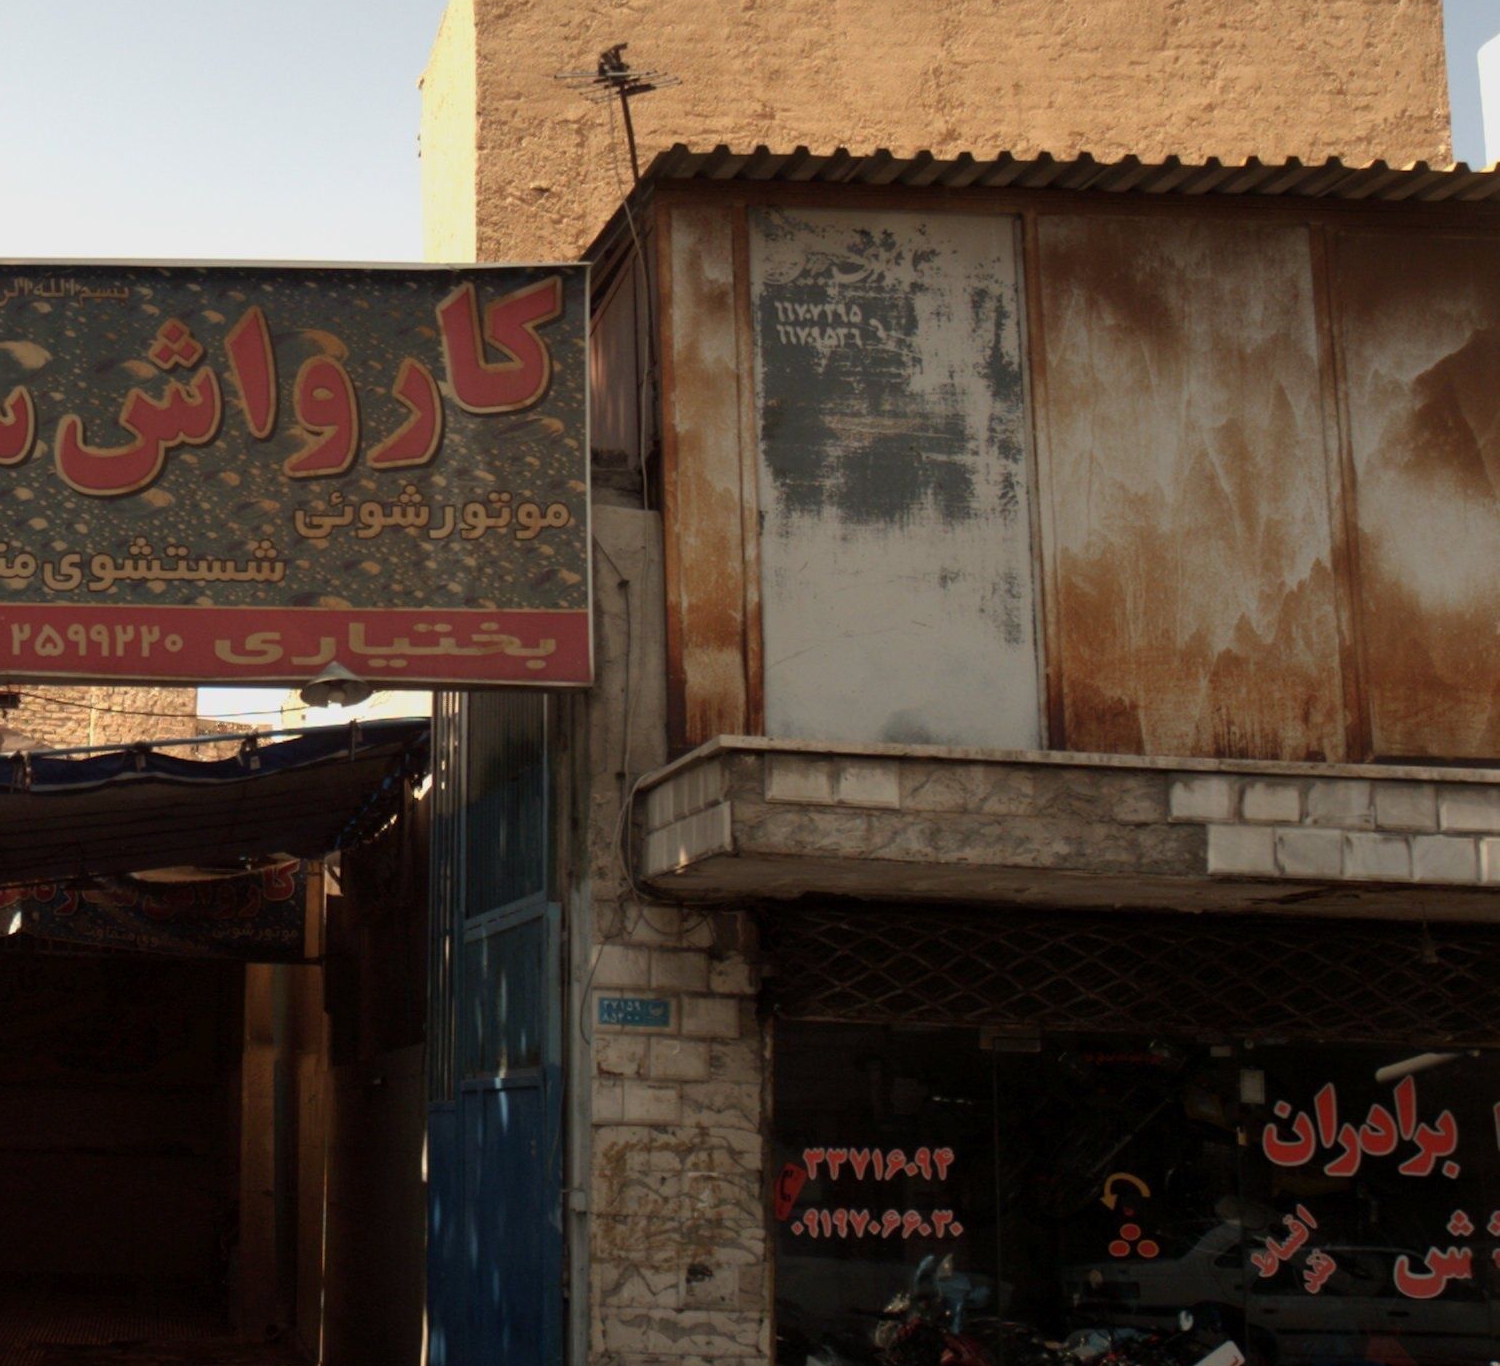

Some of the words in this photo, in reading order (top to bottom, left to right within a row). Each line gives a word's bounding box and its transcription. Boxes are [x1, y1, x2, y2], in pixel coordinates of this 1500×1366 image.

[55, 275, 566, 496] کارواش
[42, 537, 287, 592] شستشوی
[214, 620, 558, 670] بختیاری
[1262, 1075, 1460, 1179] برادران
